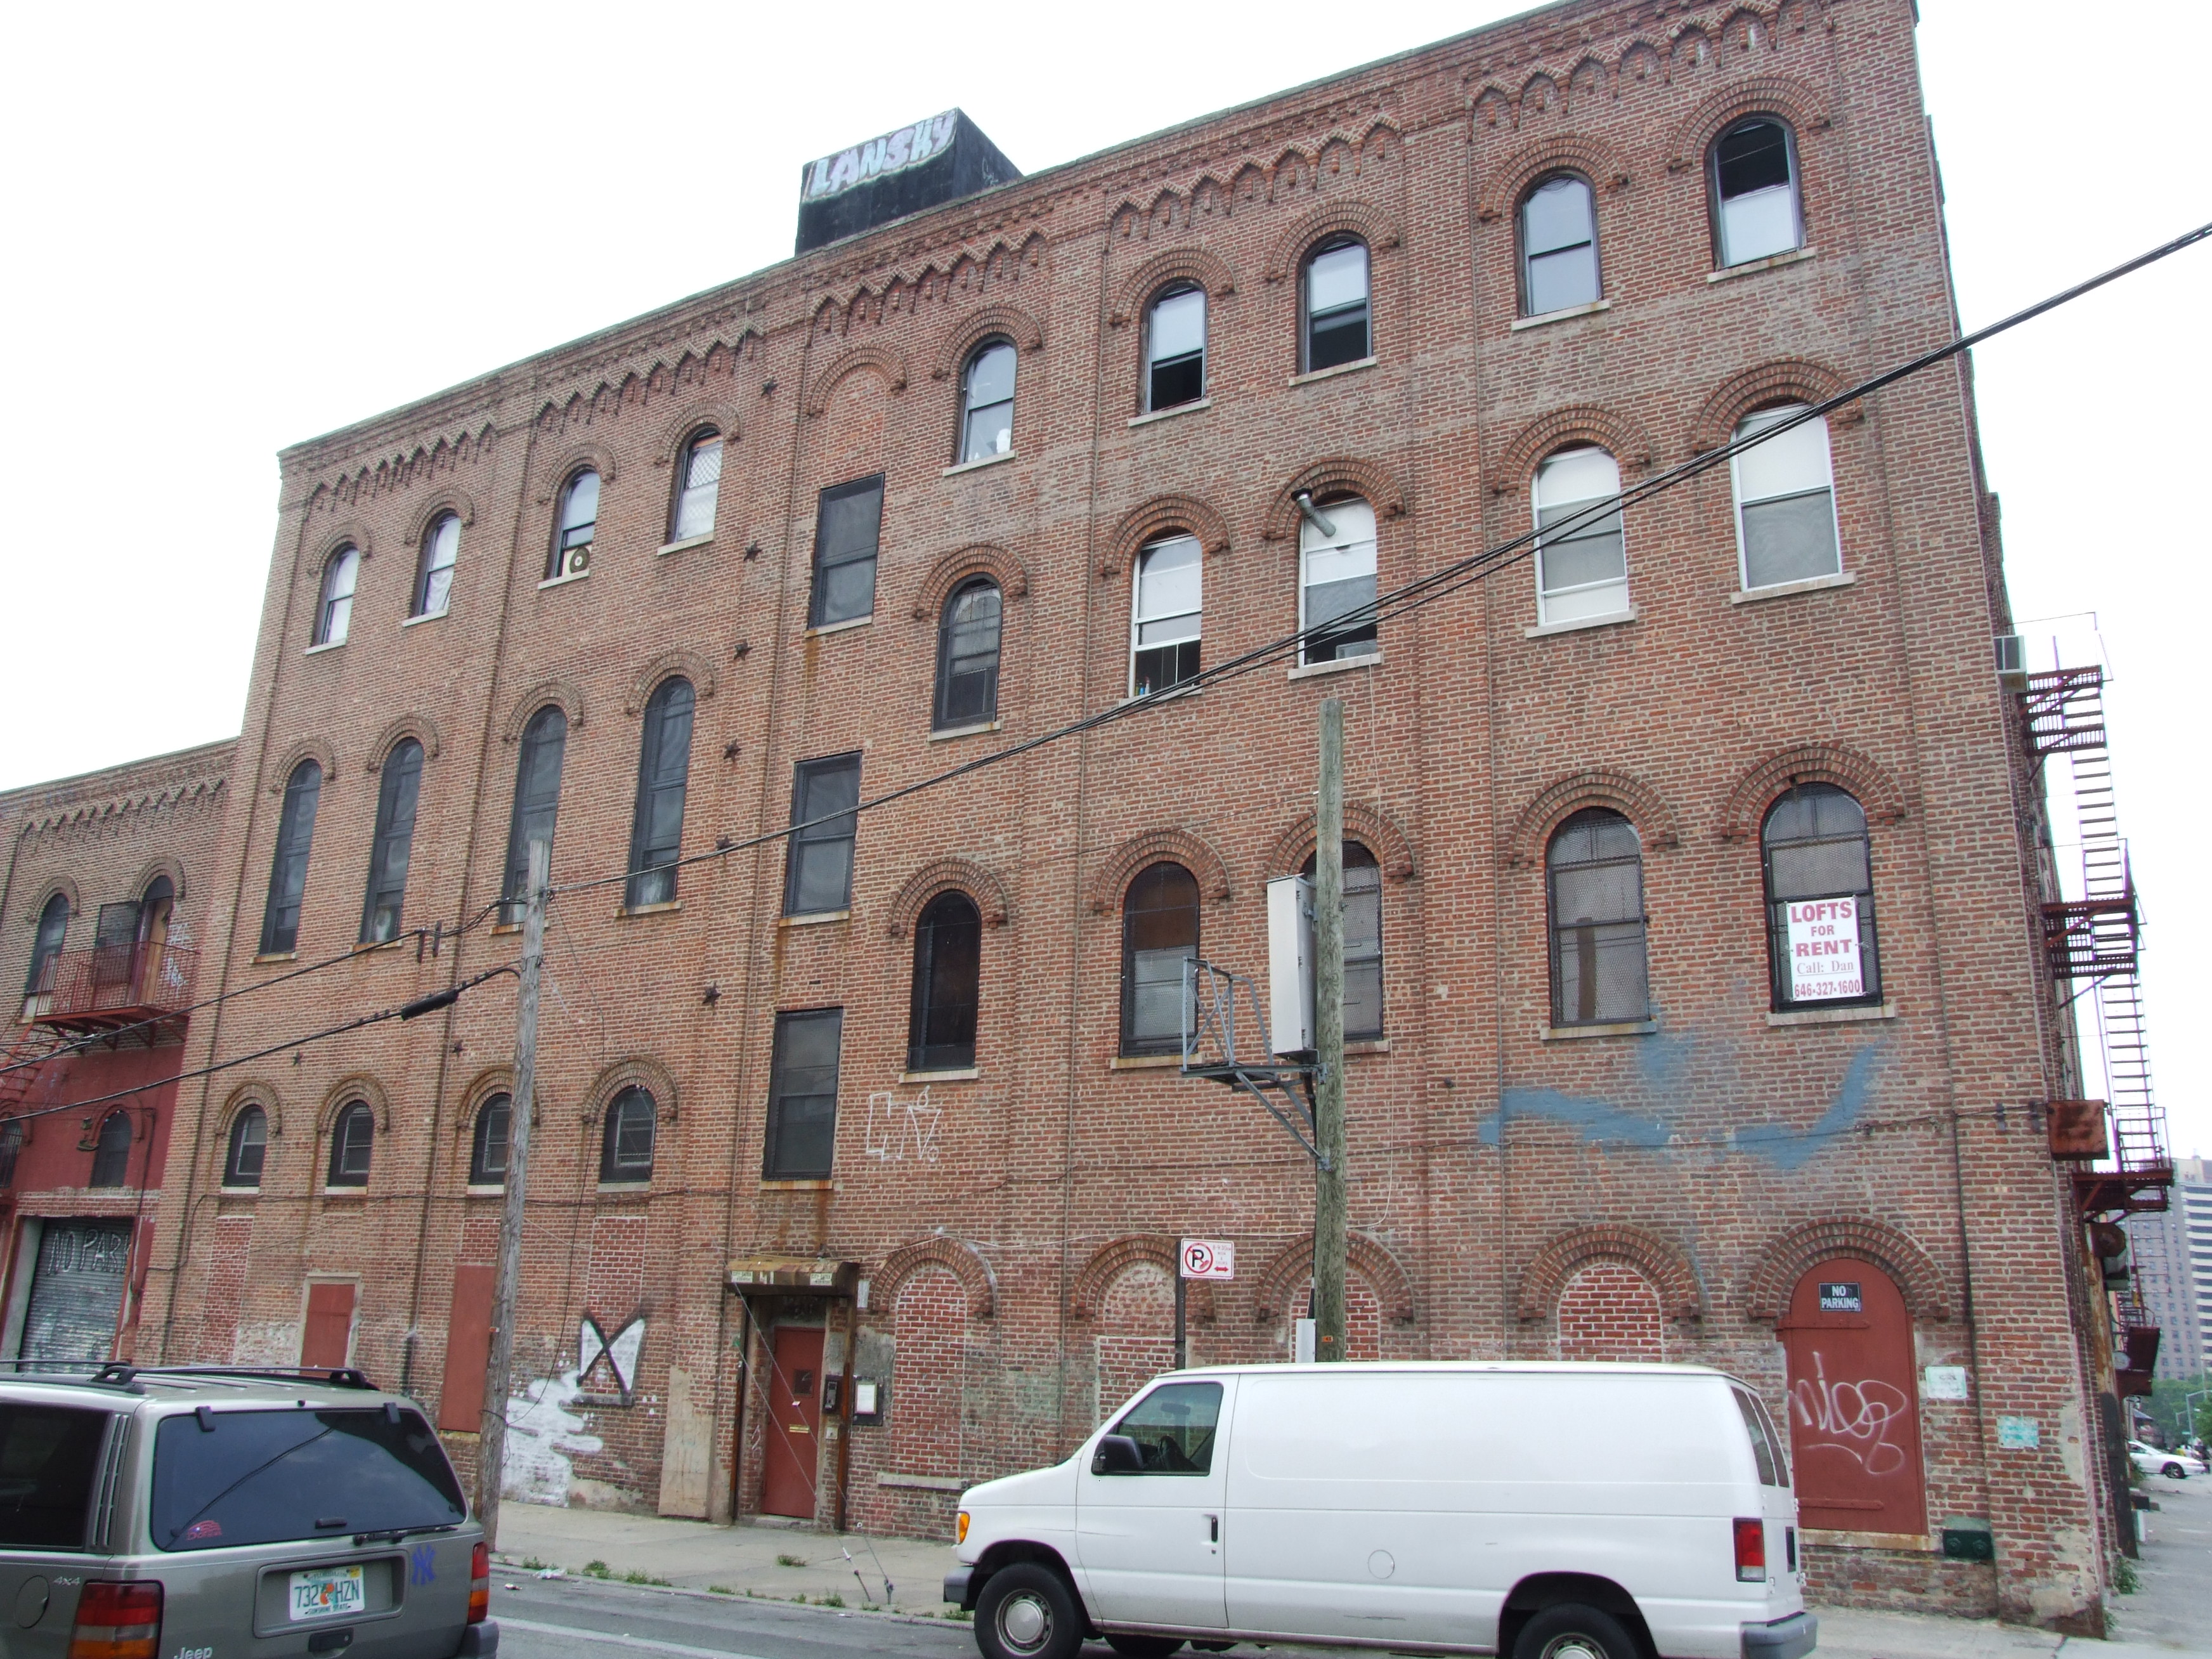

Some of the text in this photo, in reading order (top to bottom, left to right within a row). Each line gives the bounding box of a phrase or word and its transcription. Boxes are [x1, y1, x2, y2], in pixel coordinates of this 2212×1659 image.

[1791, 901, 1852, 923] LOFTS
[1811, 925, 1835, 937] FOR
[1795, 939, 1852, 957] RENT
[1797, 960, 1854, 975] Call: Dan
[48, 1230, 75, 1275] NO
[1831, 1285, 1846, 1297] NO
[1821, 1297, 1859, 1309] PARKING
[294, 1578, 360, 1609] 732 HZN
[173, 1646, 213, 1659] Jeep
